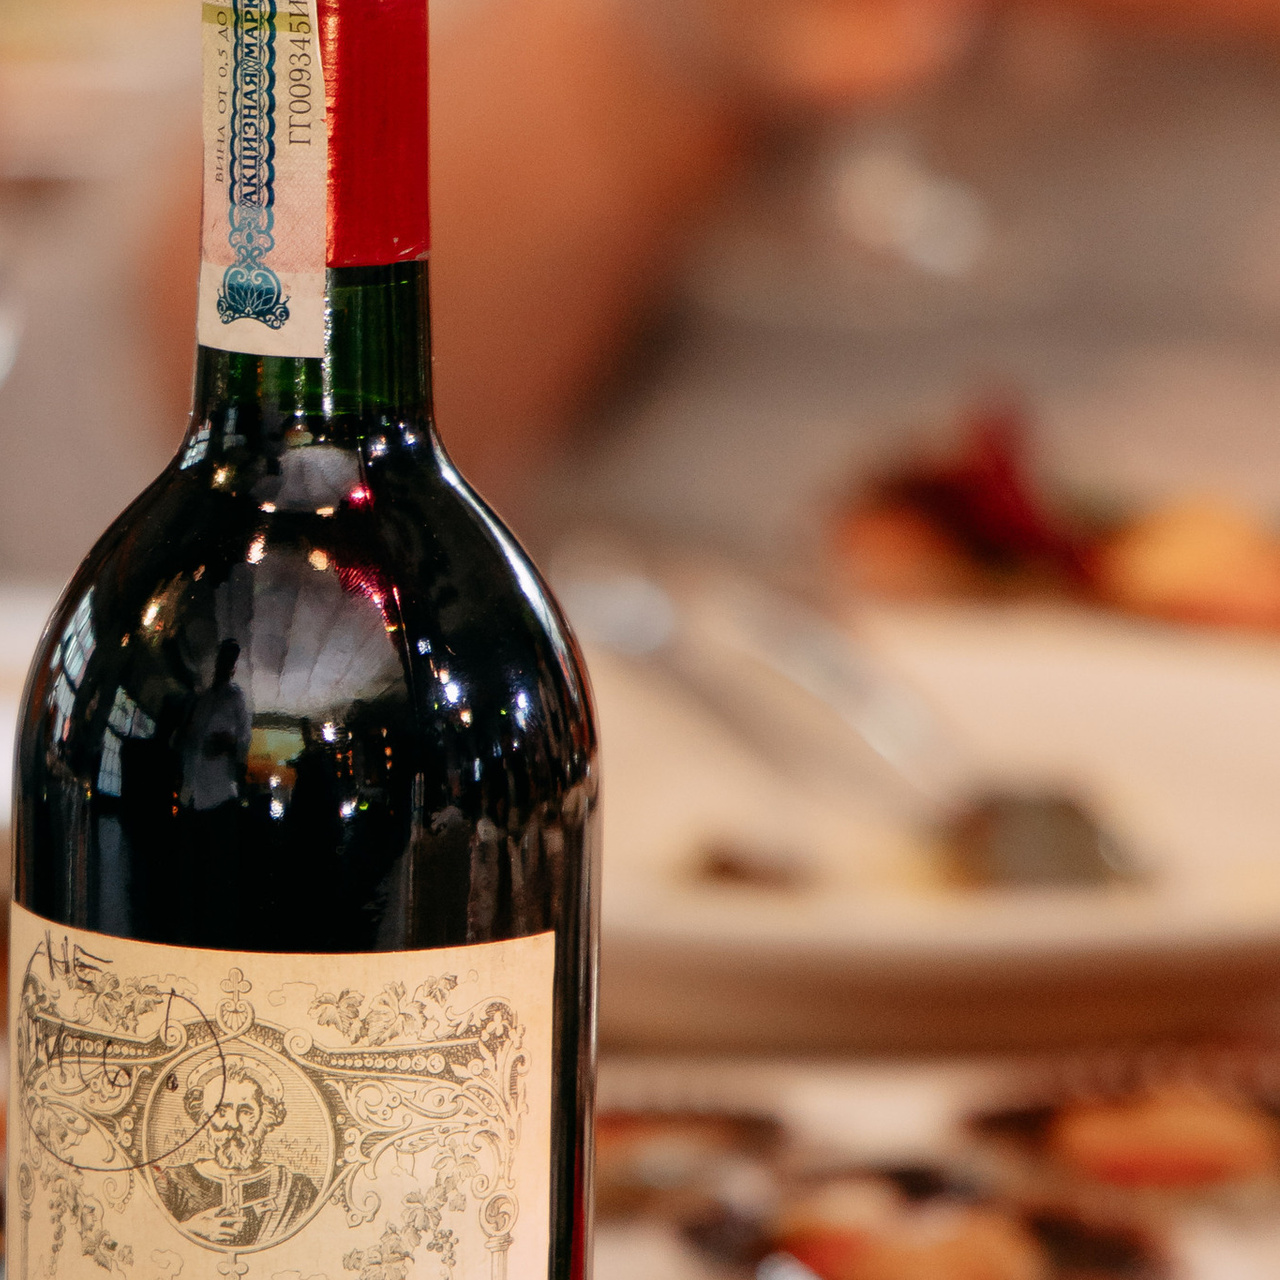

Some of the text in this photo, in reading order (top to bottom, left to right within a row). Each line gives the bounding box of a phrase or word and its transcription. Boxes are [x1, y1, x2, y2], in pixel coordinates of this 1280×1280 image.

[216, 11, 229, 42] ДО
[217, 49, 228, 78] 0,5
[218, 86, 228, 114] ОТ
[242, 72, 261, 207] АКЦИЗНАЯ
